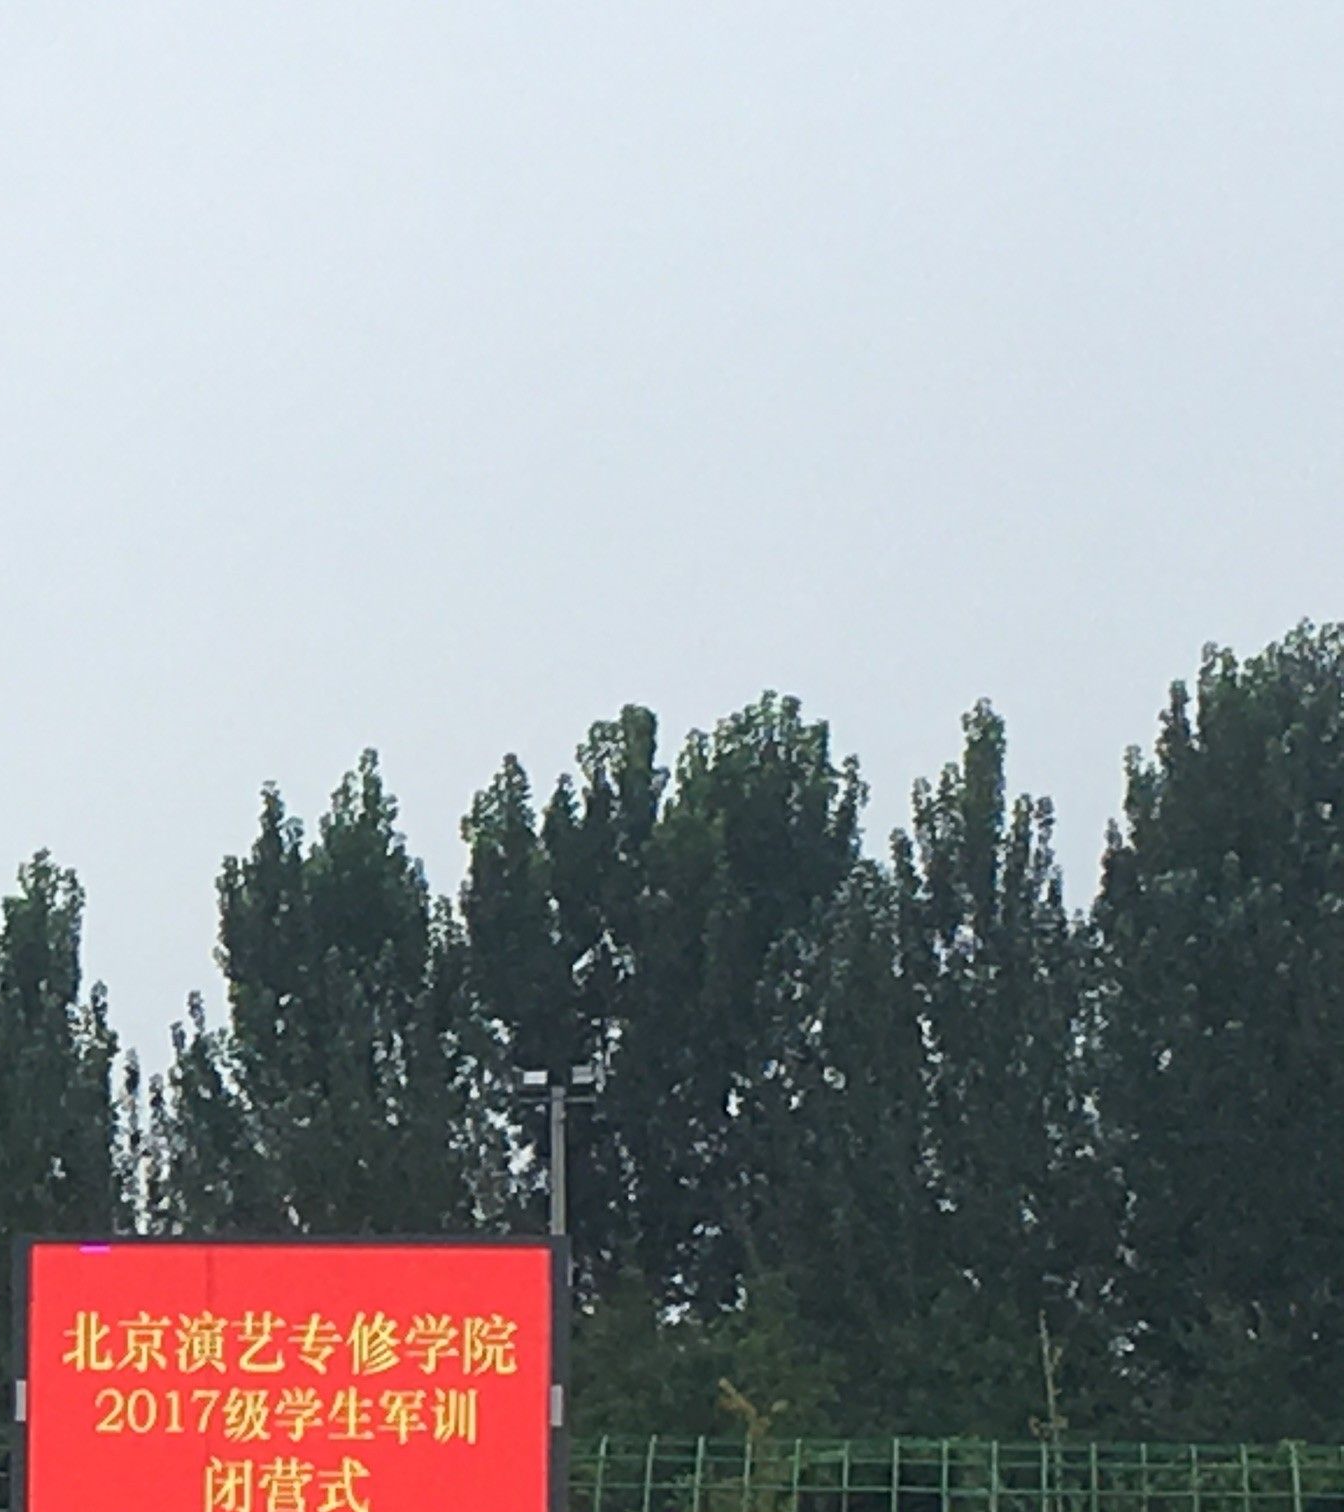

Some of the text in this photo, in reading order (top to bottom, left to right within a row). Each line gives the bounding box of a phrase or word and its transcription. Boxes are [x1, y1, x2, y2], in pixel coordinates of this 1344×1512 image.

[63, 1311, 518, 1375] 北京演艺专修学院
[94, 1386, 479, 1445] 2017级学生军训
